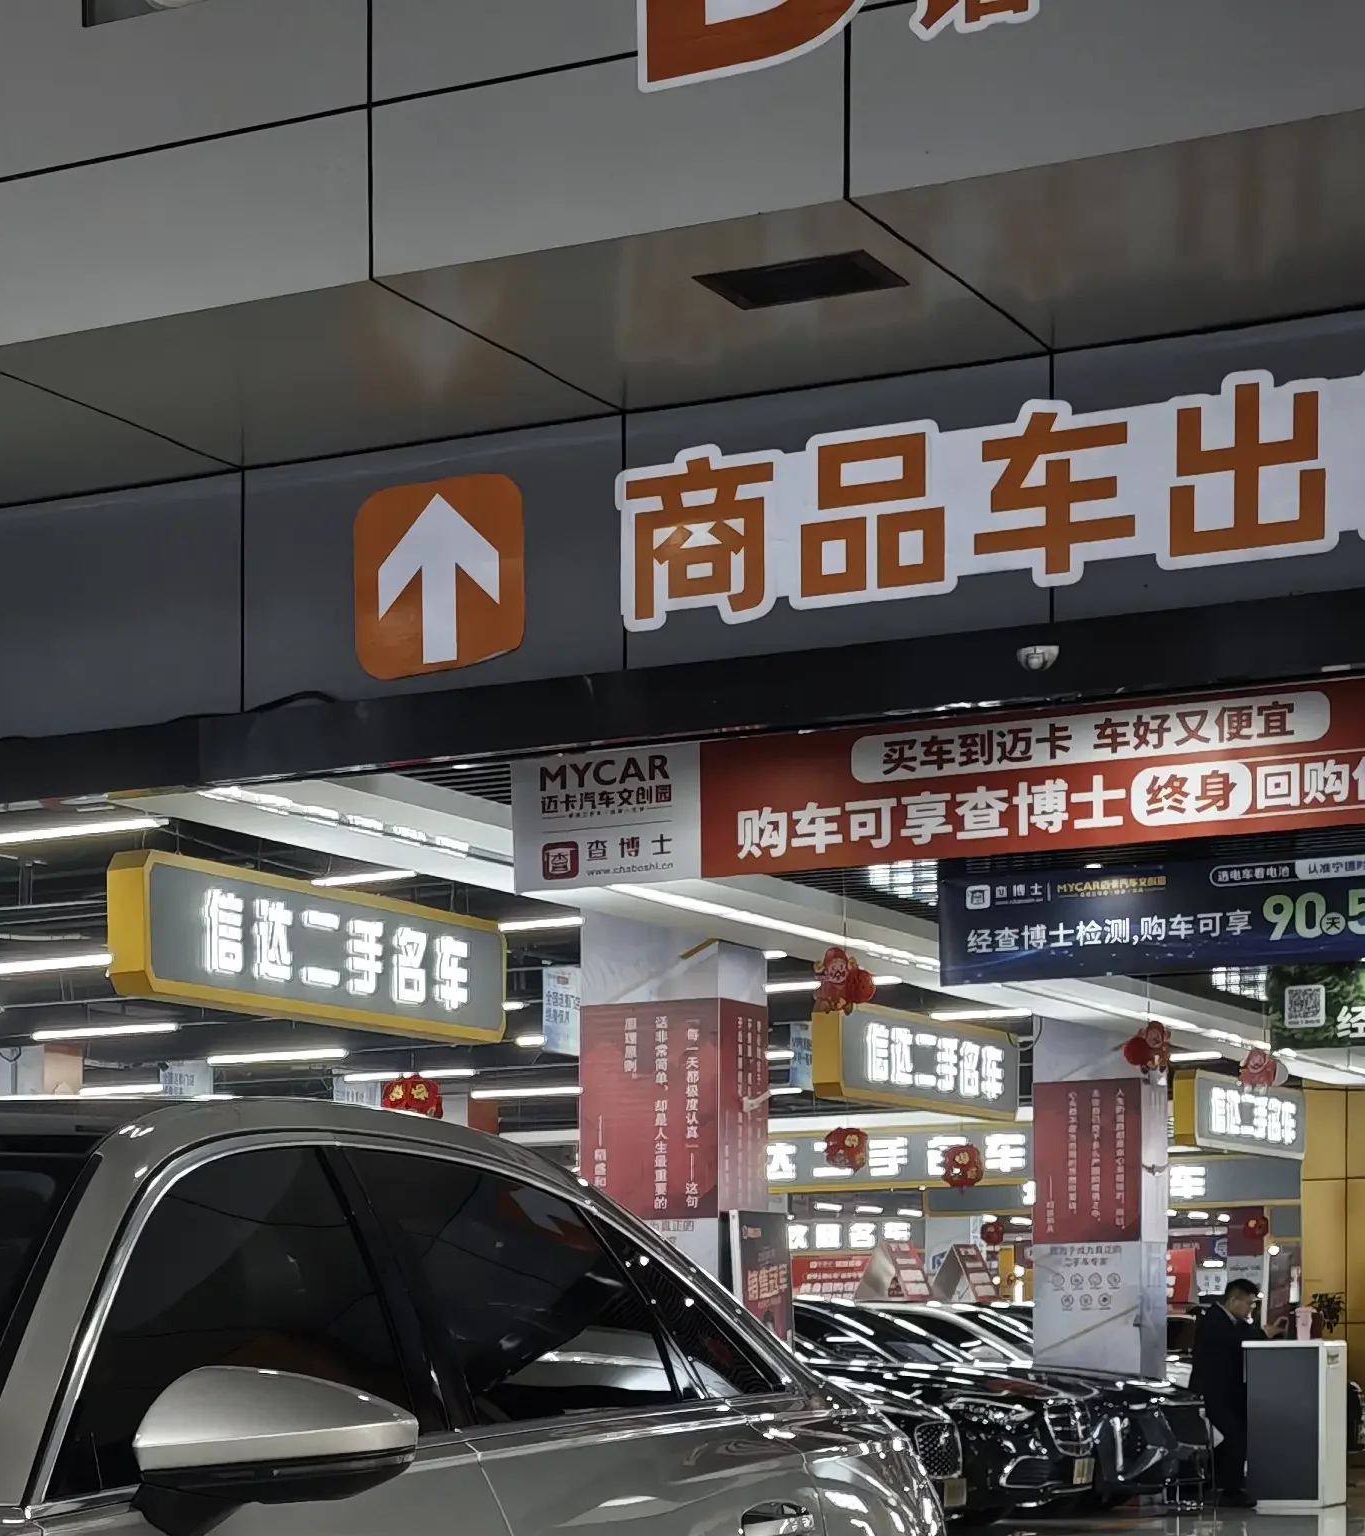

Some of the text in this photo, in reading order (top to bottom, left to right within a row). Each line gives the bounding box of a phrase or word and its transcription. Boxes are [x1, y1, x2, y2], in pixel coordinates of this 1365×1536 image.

[619, 380, 1327, 622] 商品车出
[539, 754, 669, 791] MYCAR
[881, 702, 1295, 774] 买车到迈卡 车好又便宜
[541, 783, 672, 814] 迈卡汽车文创园
[735, 755, 1365, 860] 购车可享查博士终身回购
[586, 833, 672, 862] 查博士
[201, 888, 471, 1012] 信达二手名车
[967, 908, 1253, 954] 经查博士检测,购车可享
[866, 1022, 1006, 1100] 信达二手名车
